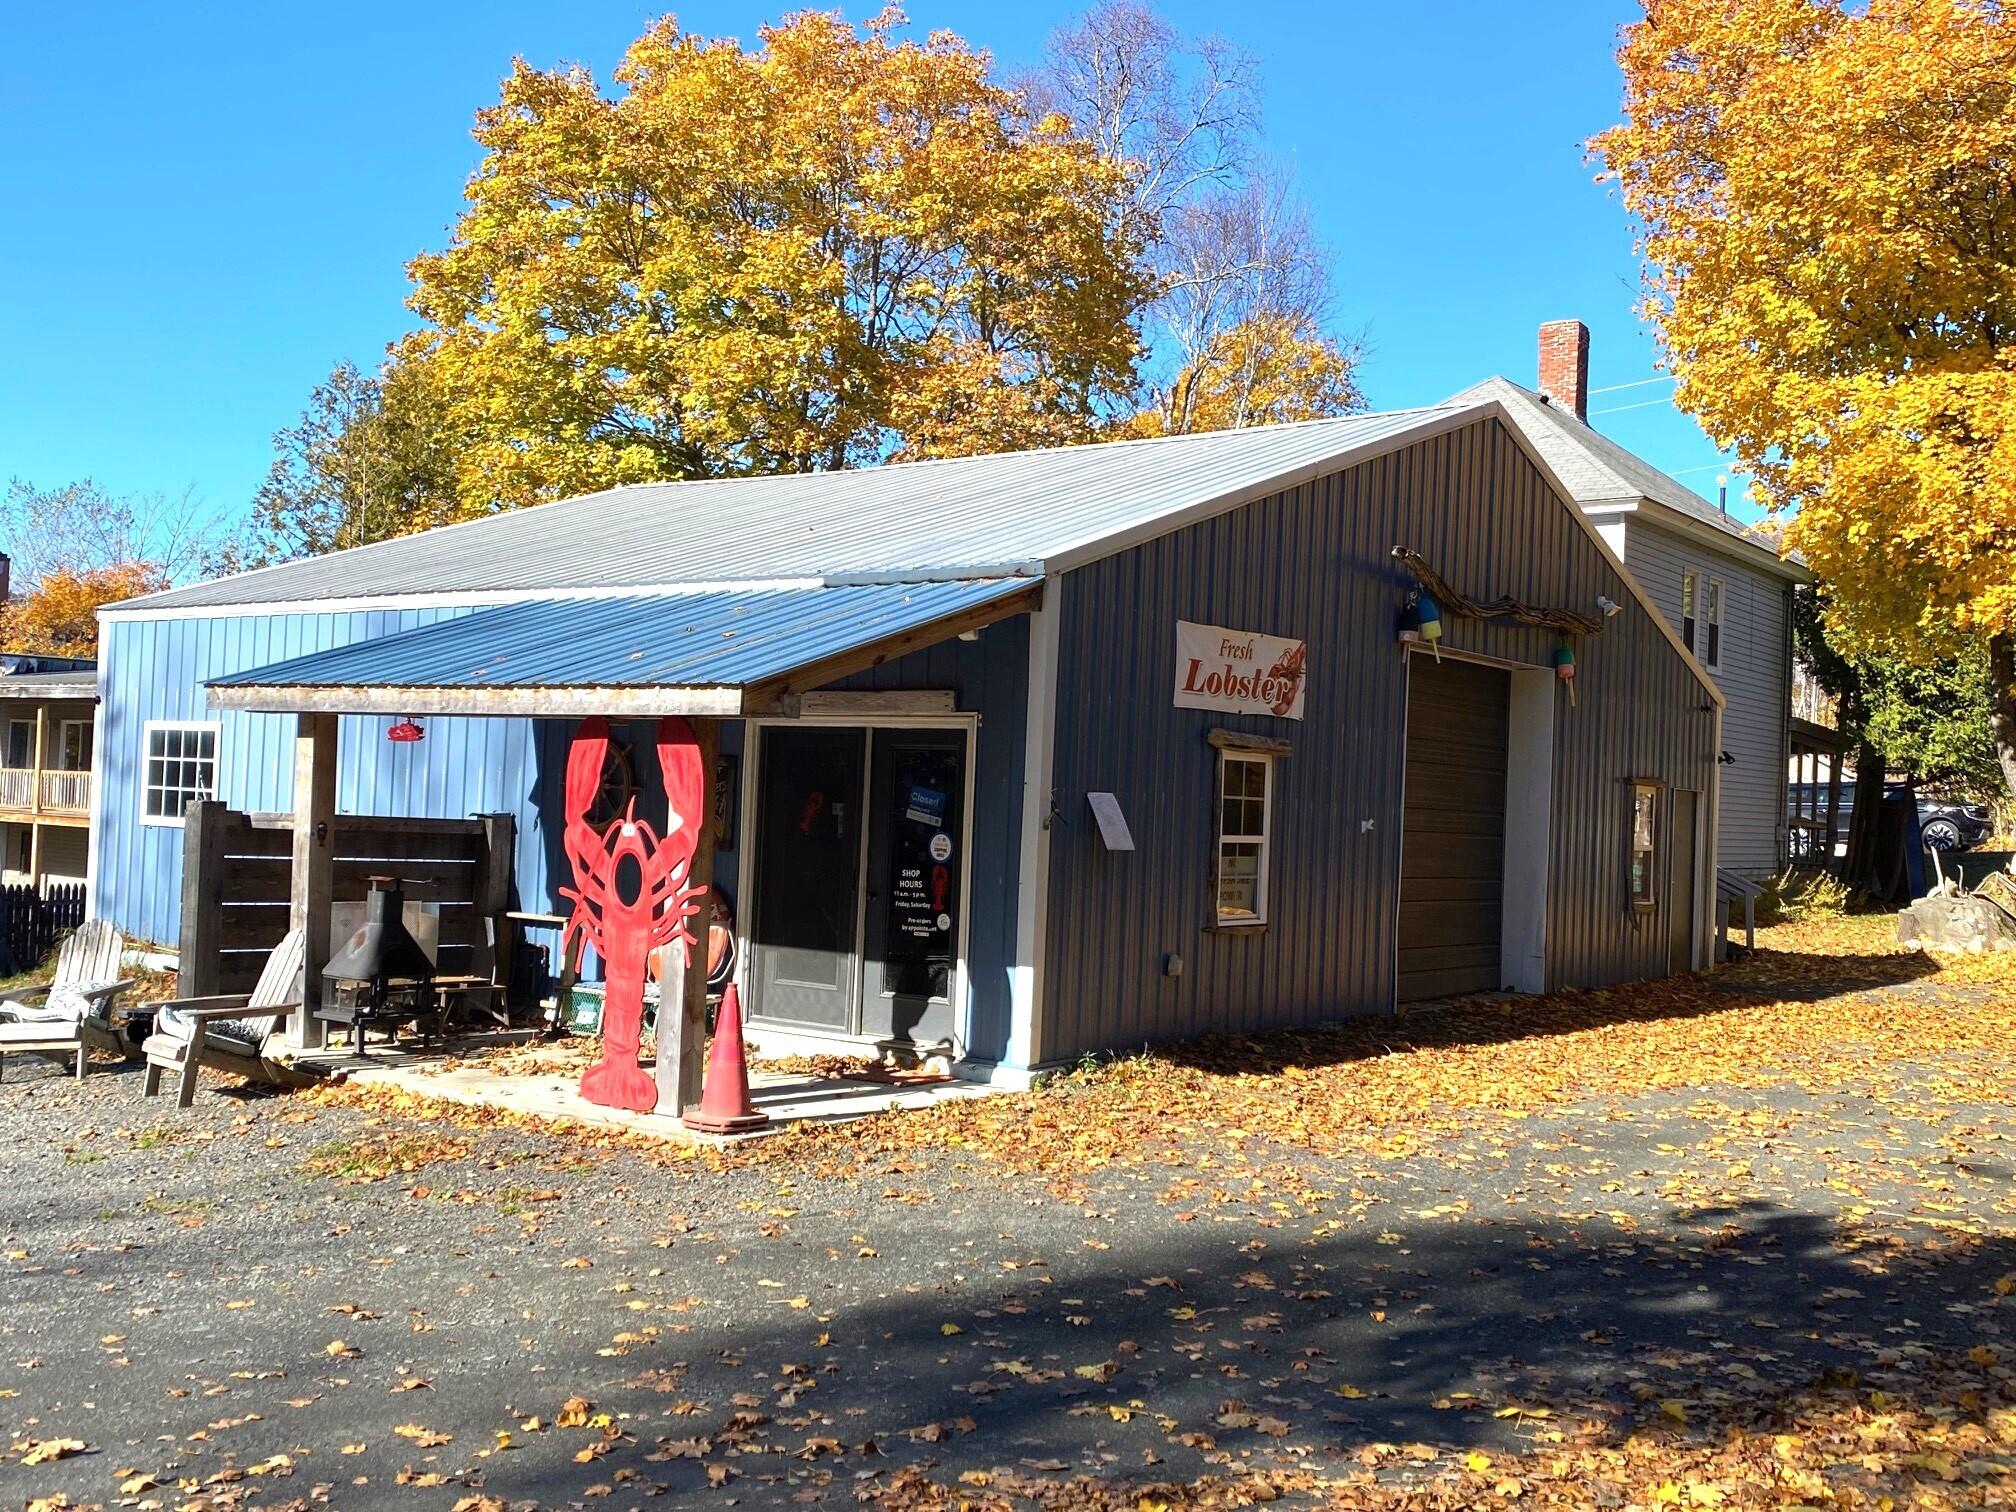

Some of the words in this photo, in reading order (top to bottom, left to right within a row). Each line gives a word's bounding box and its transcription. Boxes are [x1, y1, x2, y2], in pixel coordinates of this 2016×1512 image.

[1218, 638, 1254, 661] Fresh
[1181, 658, 1290, 704] Lobster
[911, 791, 940, 806] Closed
[902, 869, 921, 877] SHOP
[899, 880, 923, 888] HOURS
[910, 901, 931, 909] Saturday
